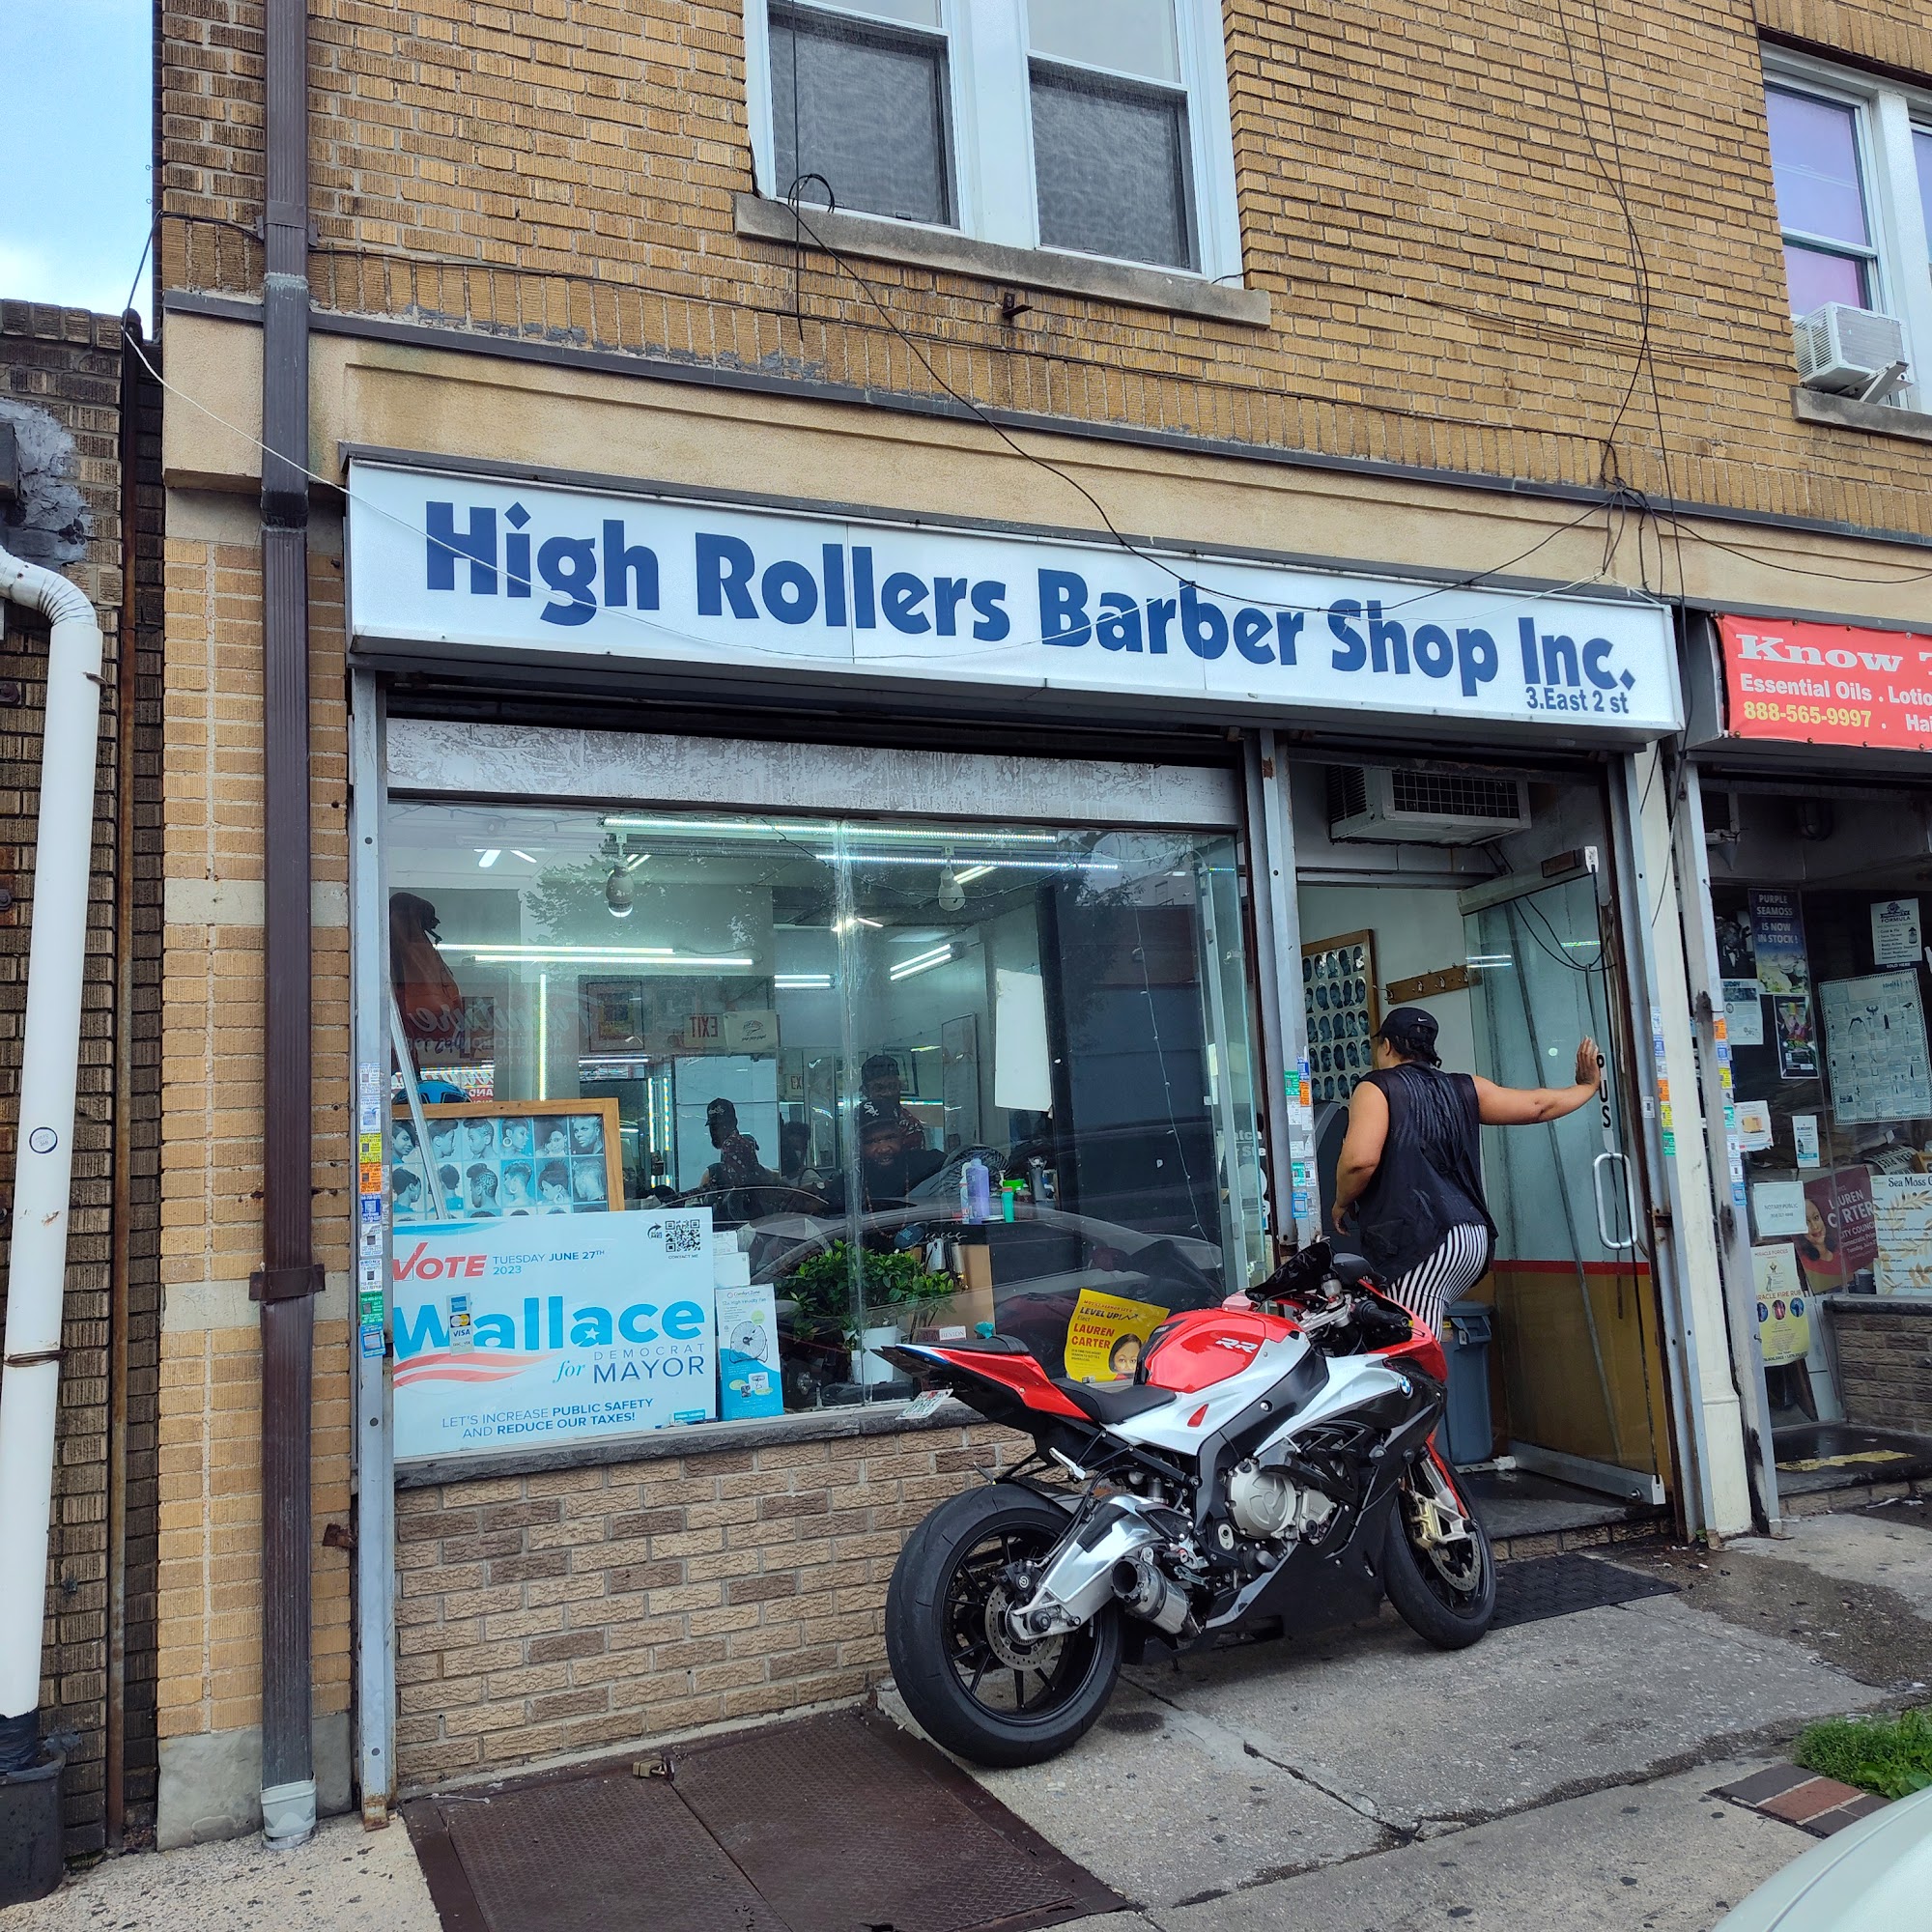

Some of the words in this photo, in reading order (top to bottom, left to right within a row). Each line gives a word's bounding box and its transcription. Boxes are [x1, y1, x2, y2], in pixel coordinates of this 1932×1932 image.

[426, 501, 660, 626] High
[696, 532, 1010, 641] Rollers
[1037, 568, 1305, 667] Barber
[1328, 599, 1499, 697] Shop
[1518, 617, 1636, 691] Inc.
[1736, 634, 1904, 672] Know
[1740, 673, 1831, 698] Essential
[1835, 682, 1872, 701] Oils
[1592, 690, 1605, 714] 2
[1609, 691, 1630, 715] st
[1743, 701, 1872, 728] 888-565-9997
[1758, 894, 1788, 904] PURPLE
[1756, 906, 1793, 917] SEAMOSS
[1761, 922, 1769, 931] IS
[1770, 922, 1791, 932] NOW
[1757, 934, 1767, 943] IN
[1768, 934, 1794, 944] STOCK
[1889, 1177, 1903, 1187] Sea
[1904, 1176, 1926, 1187] Moss
[1828, 1189, 1864, 1209] LUREN
[1827, 1201, 1875, 1228] CRTER
[393, 1242, 487, 1281] VOTE
[493, 1254, 546, 1264] TUESDAY
[548, 1251, 580, 1263] JUNE
[493, 1265, 522, 1275] 2023
[1756, 1293, 1776, 1301] IRACLE
[1080, 1307, 1106, 1318] LEVEL
[393, 1295, 705, 1358] Wallace
[453, 1328, 470, 1337] VISA
[1073, 1323, 1115, 1338] LAUREN
[1071, 1335, 1111, 1350] CARTER
[1215, 1337, 1259, 1353] RR
[594, 1343, 705, 1361] DEMOCRAT
[553, 1360, 585, 1383] for
[593, 1355, 705, 1384] MAYOR
[442, 1415, 478, 1428] LET'S
[483, 1408, 549, 1425] INCREASE
[553, 1404, 601, 1417] PUBLIC
[604, 1398, 654, 1412] SAFETY
[463, 1426, 493, 1438] AND
[497, 1420, 554, 1435] REDUCE
[556, 1417, 586, 1429] OUR
[591, 1412, 636, 1425] TAXES!
